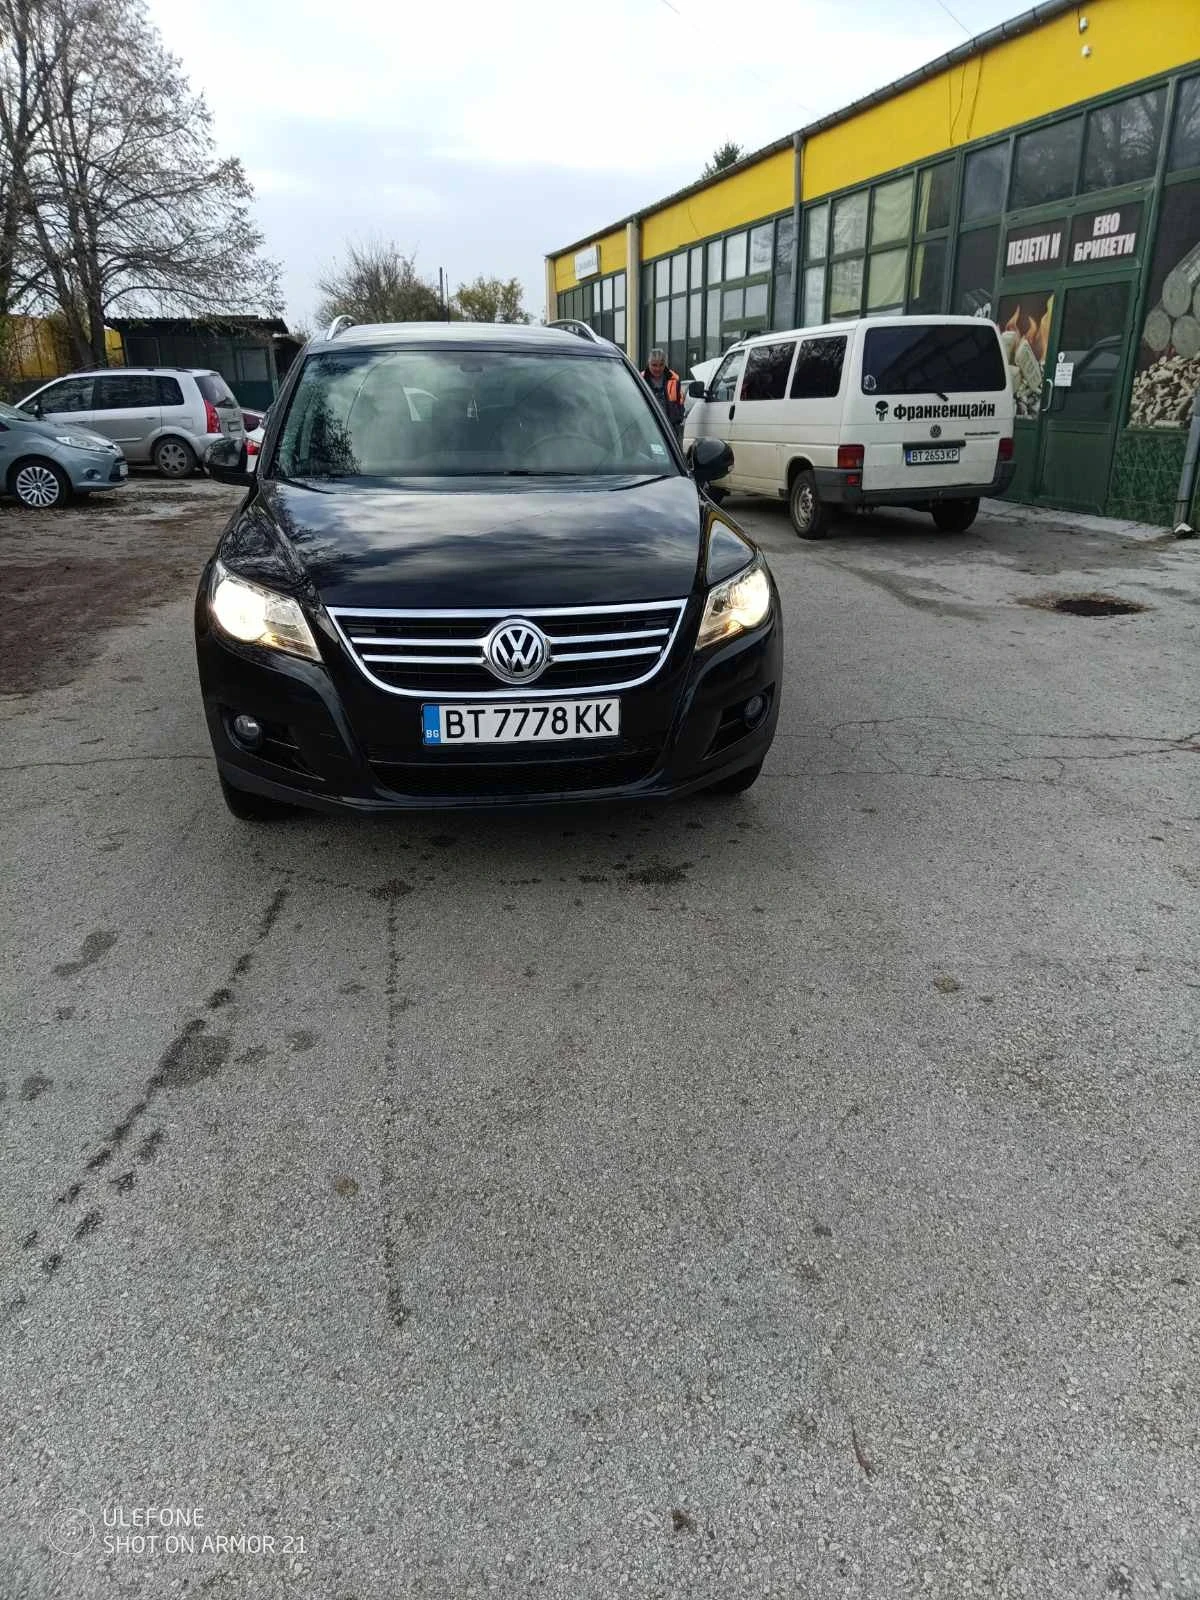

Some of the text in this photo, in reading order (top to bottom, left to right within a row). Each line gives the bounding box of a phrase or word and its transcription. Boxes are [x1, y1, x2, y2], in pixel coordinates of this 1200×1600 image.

[1093, 212, 1121, 237] ЕКО
[1007, 235, 1051, 266] ПЕЛЕТИ
[1073, 232, 1136, 263] БРИКЕТИ
[893, 400, 996, 421] Франкенщайн
[426, 729, 440, 738] BG
